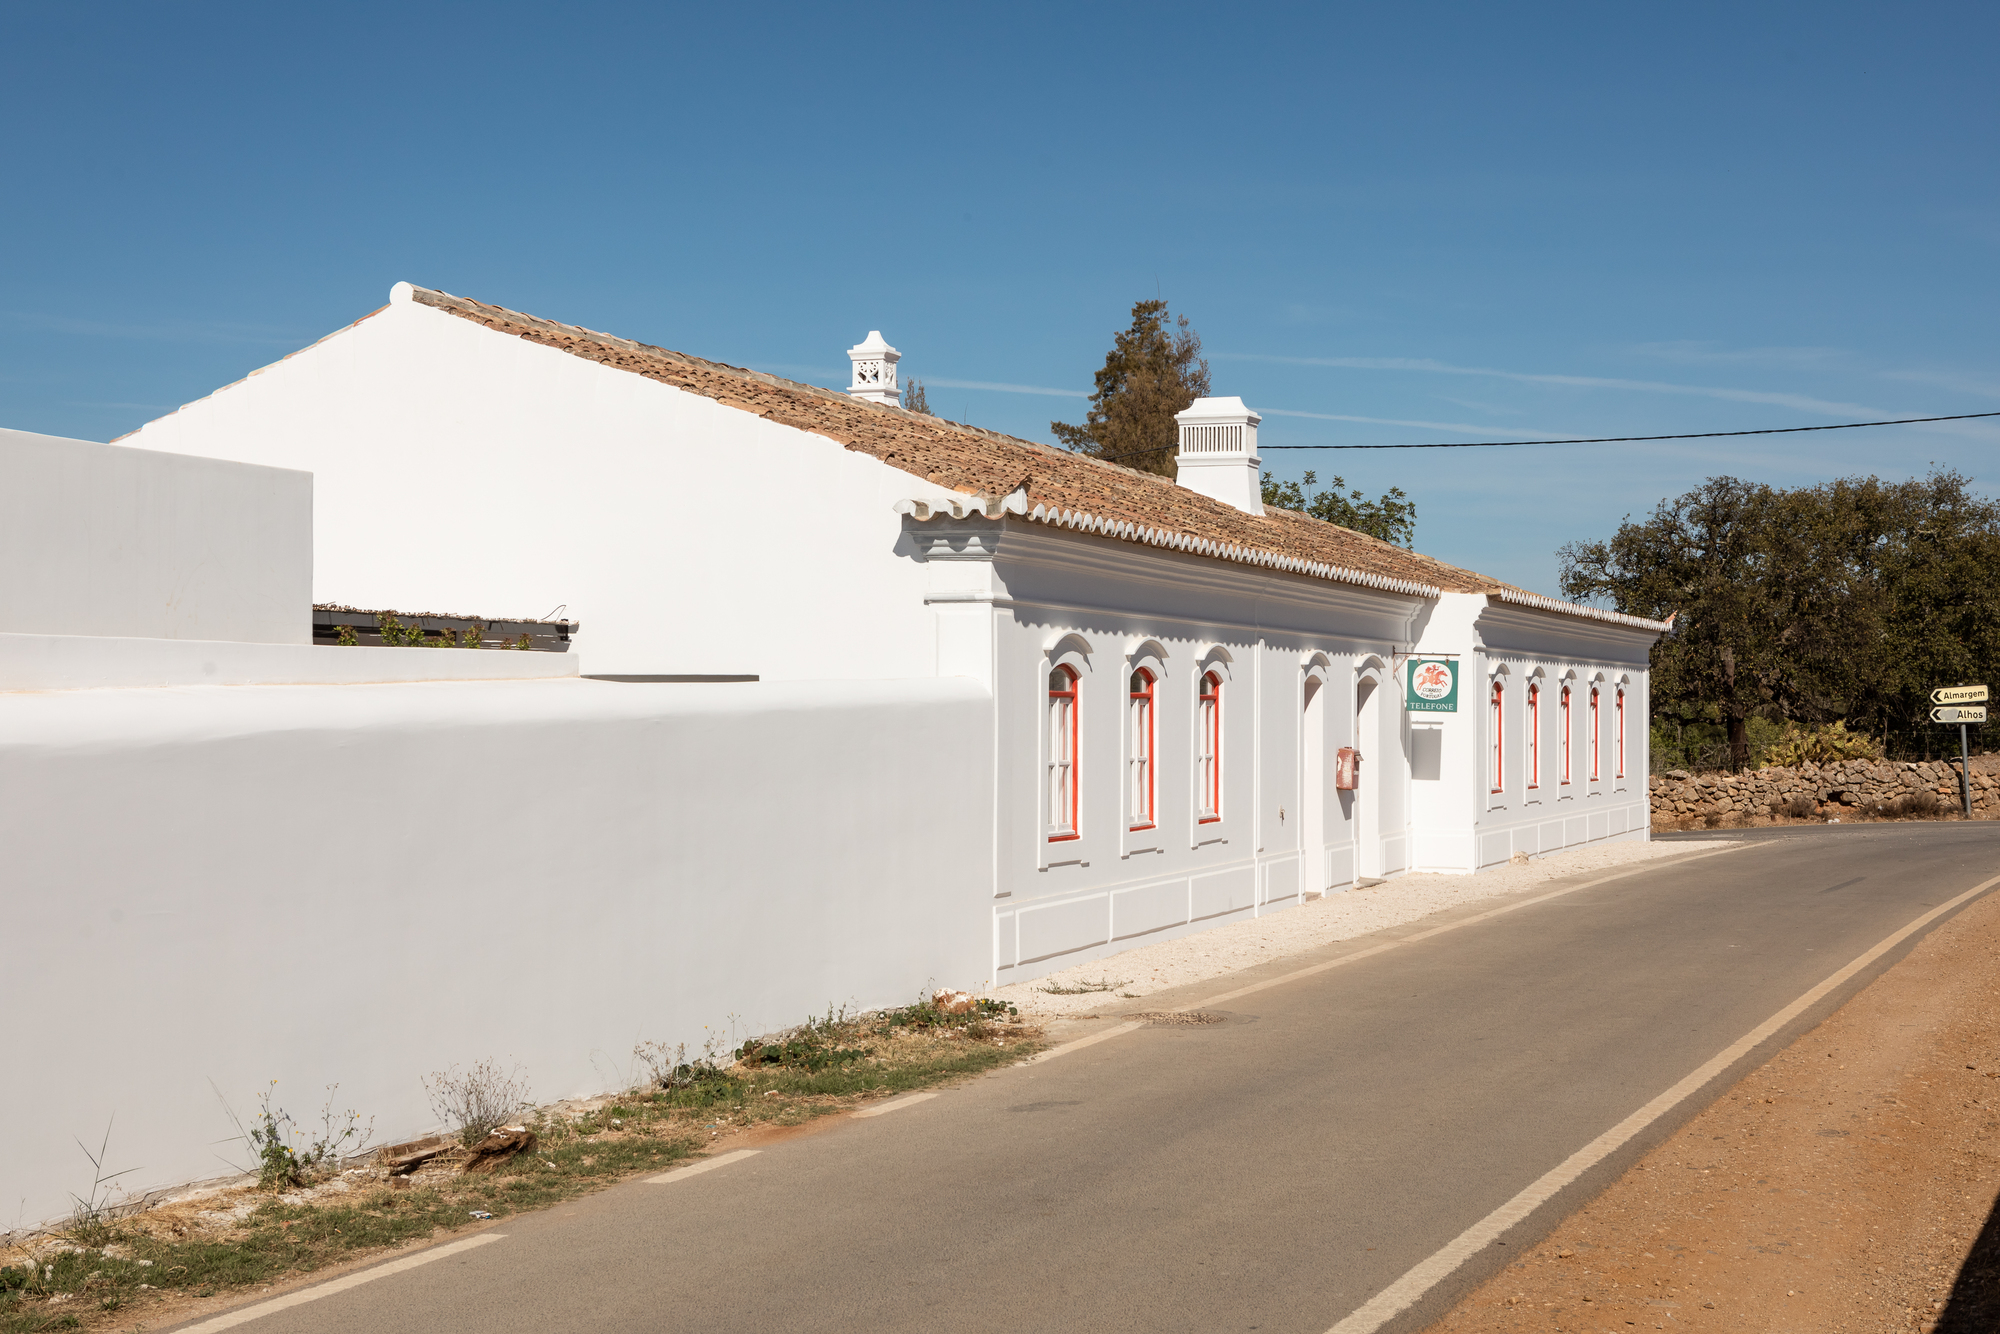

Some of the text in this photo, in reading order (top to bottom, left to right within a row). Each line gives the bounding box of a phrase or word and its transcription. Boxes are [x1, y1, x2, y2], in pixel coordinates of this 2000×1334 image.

[1943, 690, 1985, 700] Almargem
[1410, 702, 1454, 710] TELEFONE
[1957, 710, 1983, 719] Alhos
